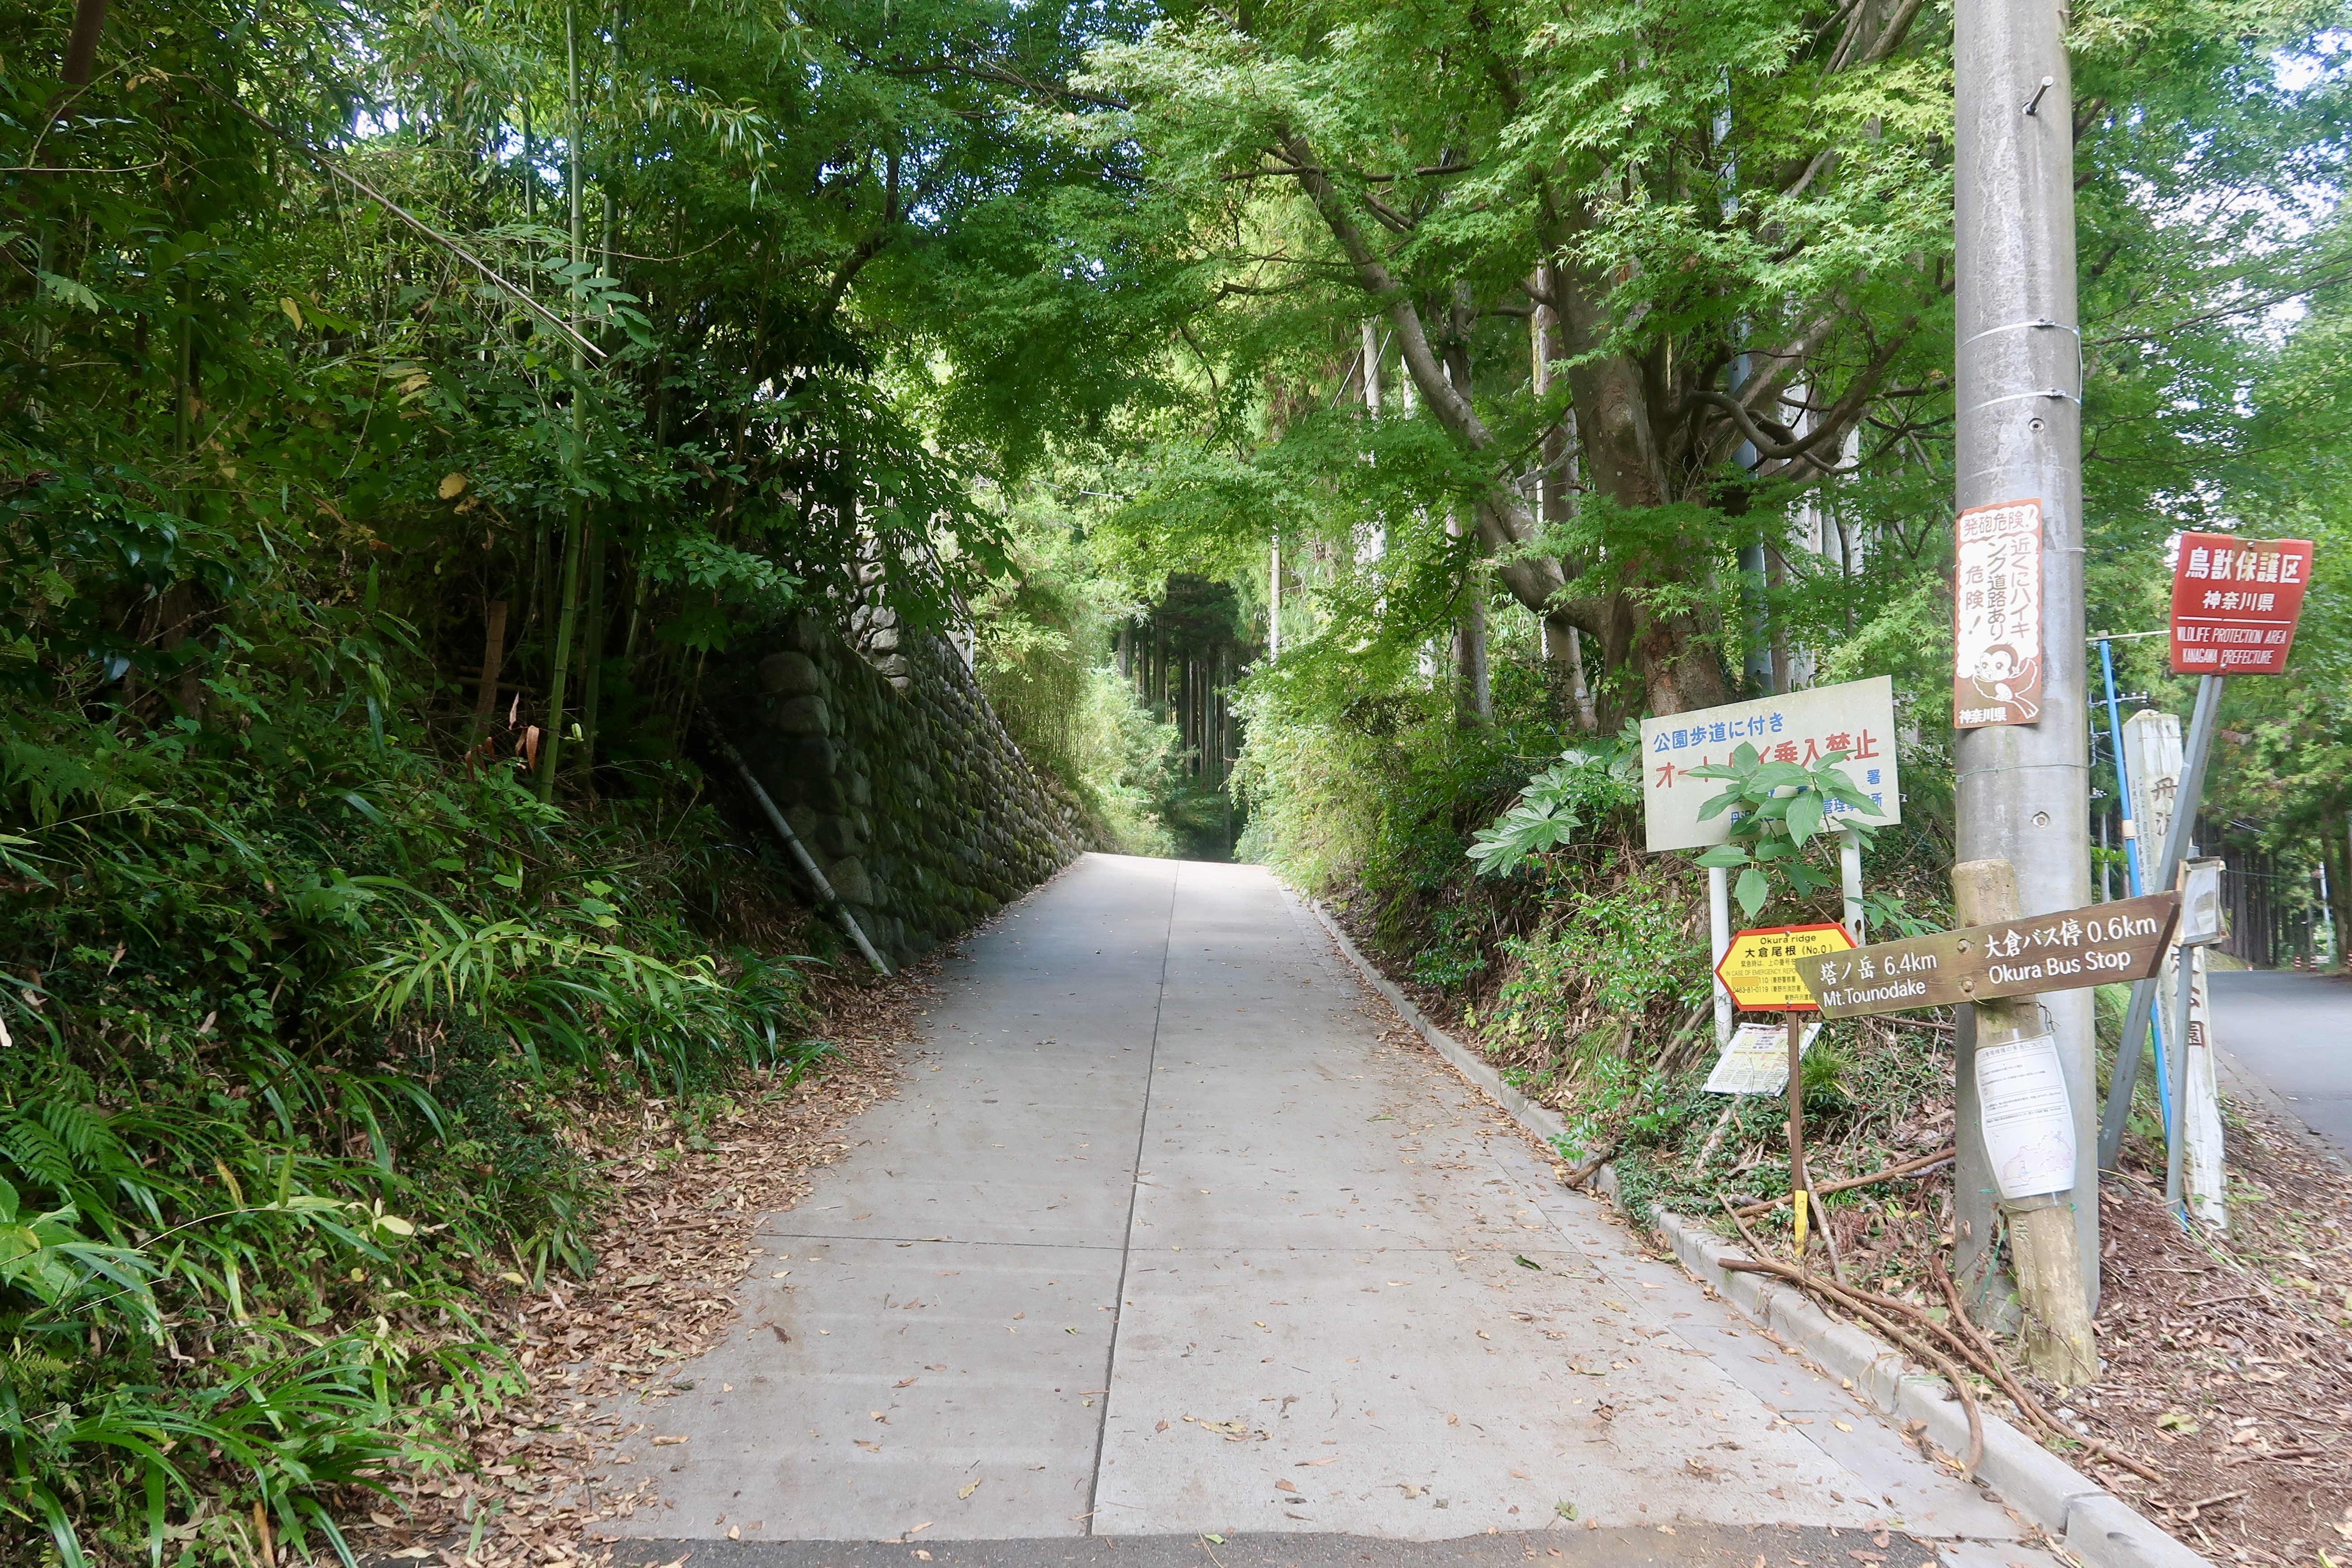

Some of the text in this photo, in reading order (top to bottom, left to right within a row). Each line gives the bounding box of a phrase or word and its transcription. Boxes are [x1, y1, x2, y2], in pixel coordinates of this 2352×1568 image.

[1963, 508, 2035, 537] 発砲危険!
[2185, 546, 2303, 584] 鳥獣保護区
[1987, 542, 2008, 642] ング道路あり
[2010, 537, 2031, 639] 近くにハイキ
[2202, 590, 2275, 611] 神奈川県
[2177, 626, 2287, 644] WILDLIFE PROTECTION AREA
[2182, 648, 2275, 665] KANAGAWA PREFECTURE
[1653, 712, 1783, 753] 公園歩道に付き
[1958, 707, 2007, 724] 神奈川県
[1656, 729, 1879, 788] オートイ乗入禁止
[1745, 945, 1796, 958] 大倉尾根
[1791, 935, 1816, 943] ridge
[1984, 915, 2158, 959] 大倉バス停 0.6km
[1820, 951, 1938, 986] 塔ノ岳 6.4km
[1989, 951, 2131, 985] Okura Bus Stop
